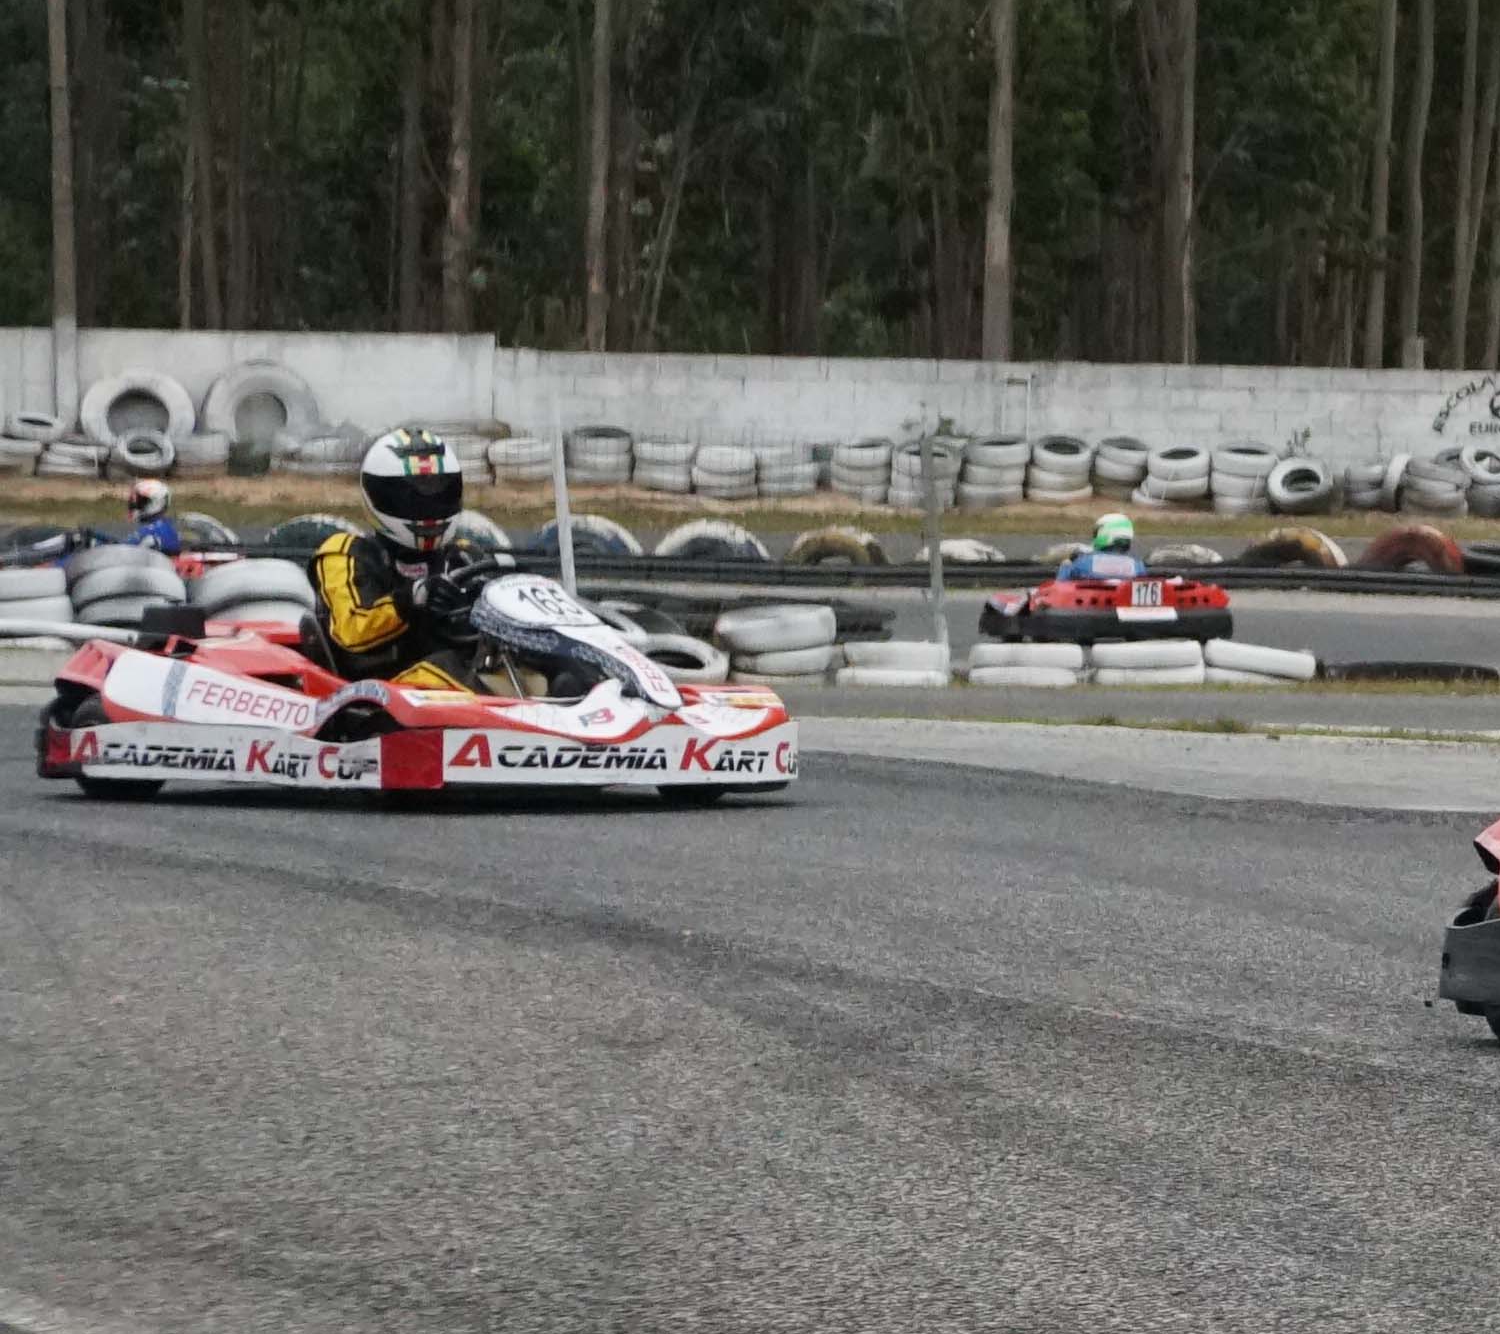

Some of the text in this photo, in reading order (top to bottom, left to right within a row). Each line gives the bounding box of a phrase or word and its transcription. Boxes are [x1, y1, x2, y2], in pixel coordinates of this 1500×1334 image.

[516, 587, 584, 617] 165
[1136, 581, 1159, 606] 176
[186, 679, 310, 728] FERBERTO
[448, 733, 668, 772] ACADEMIA
